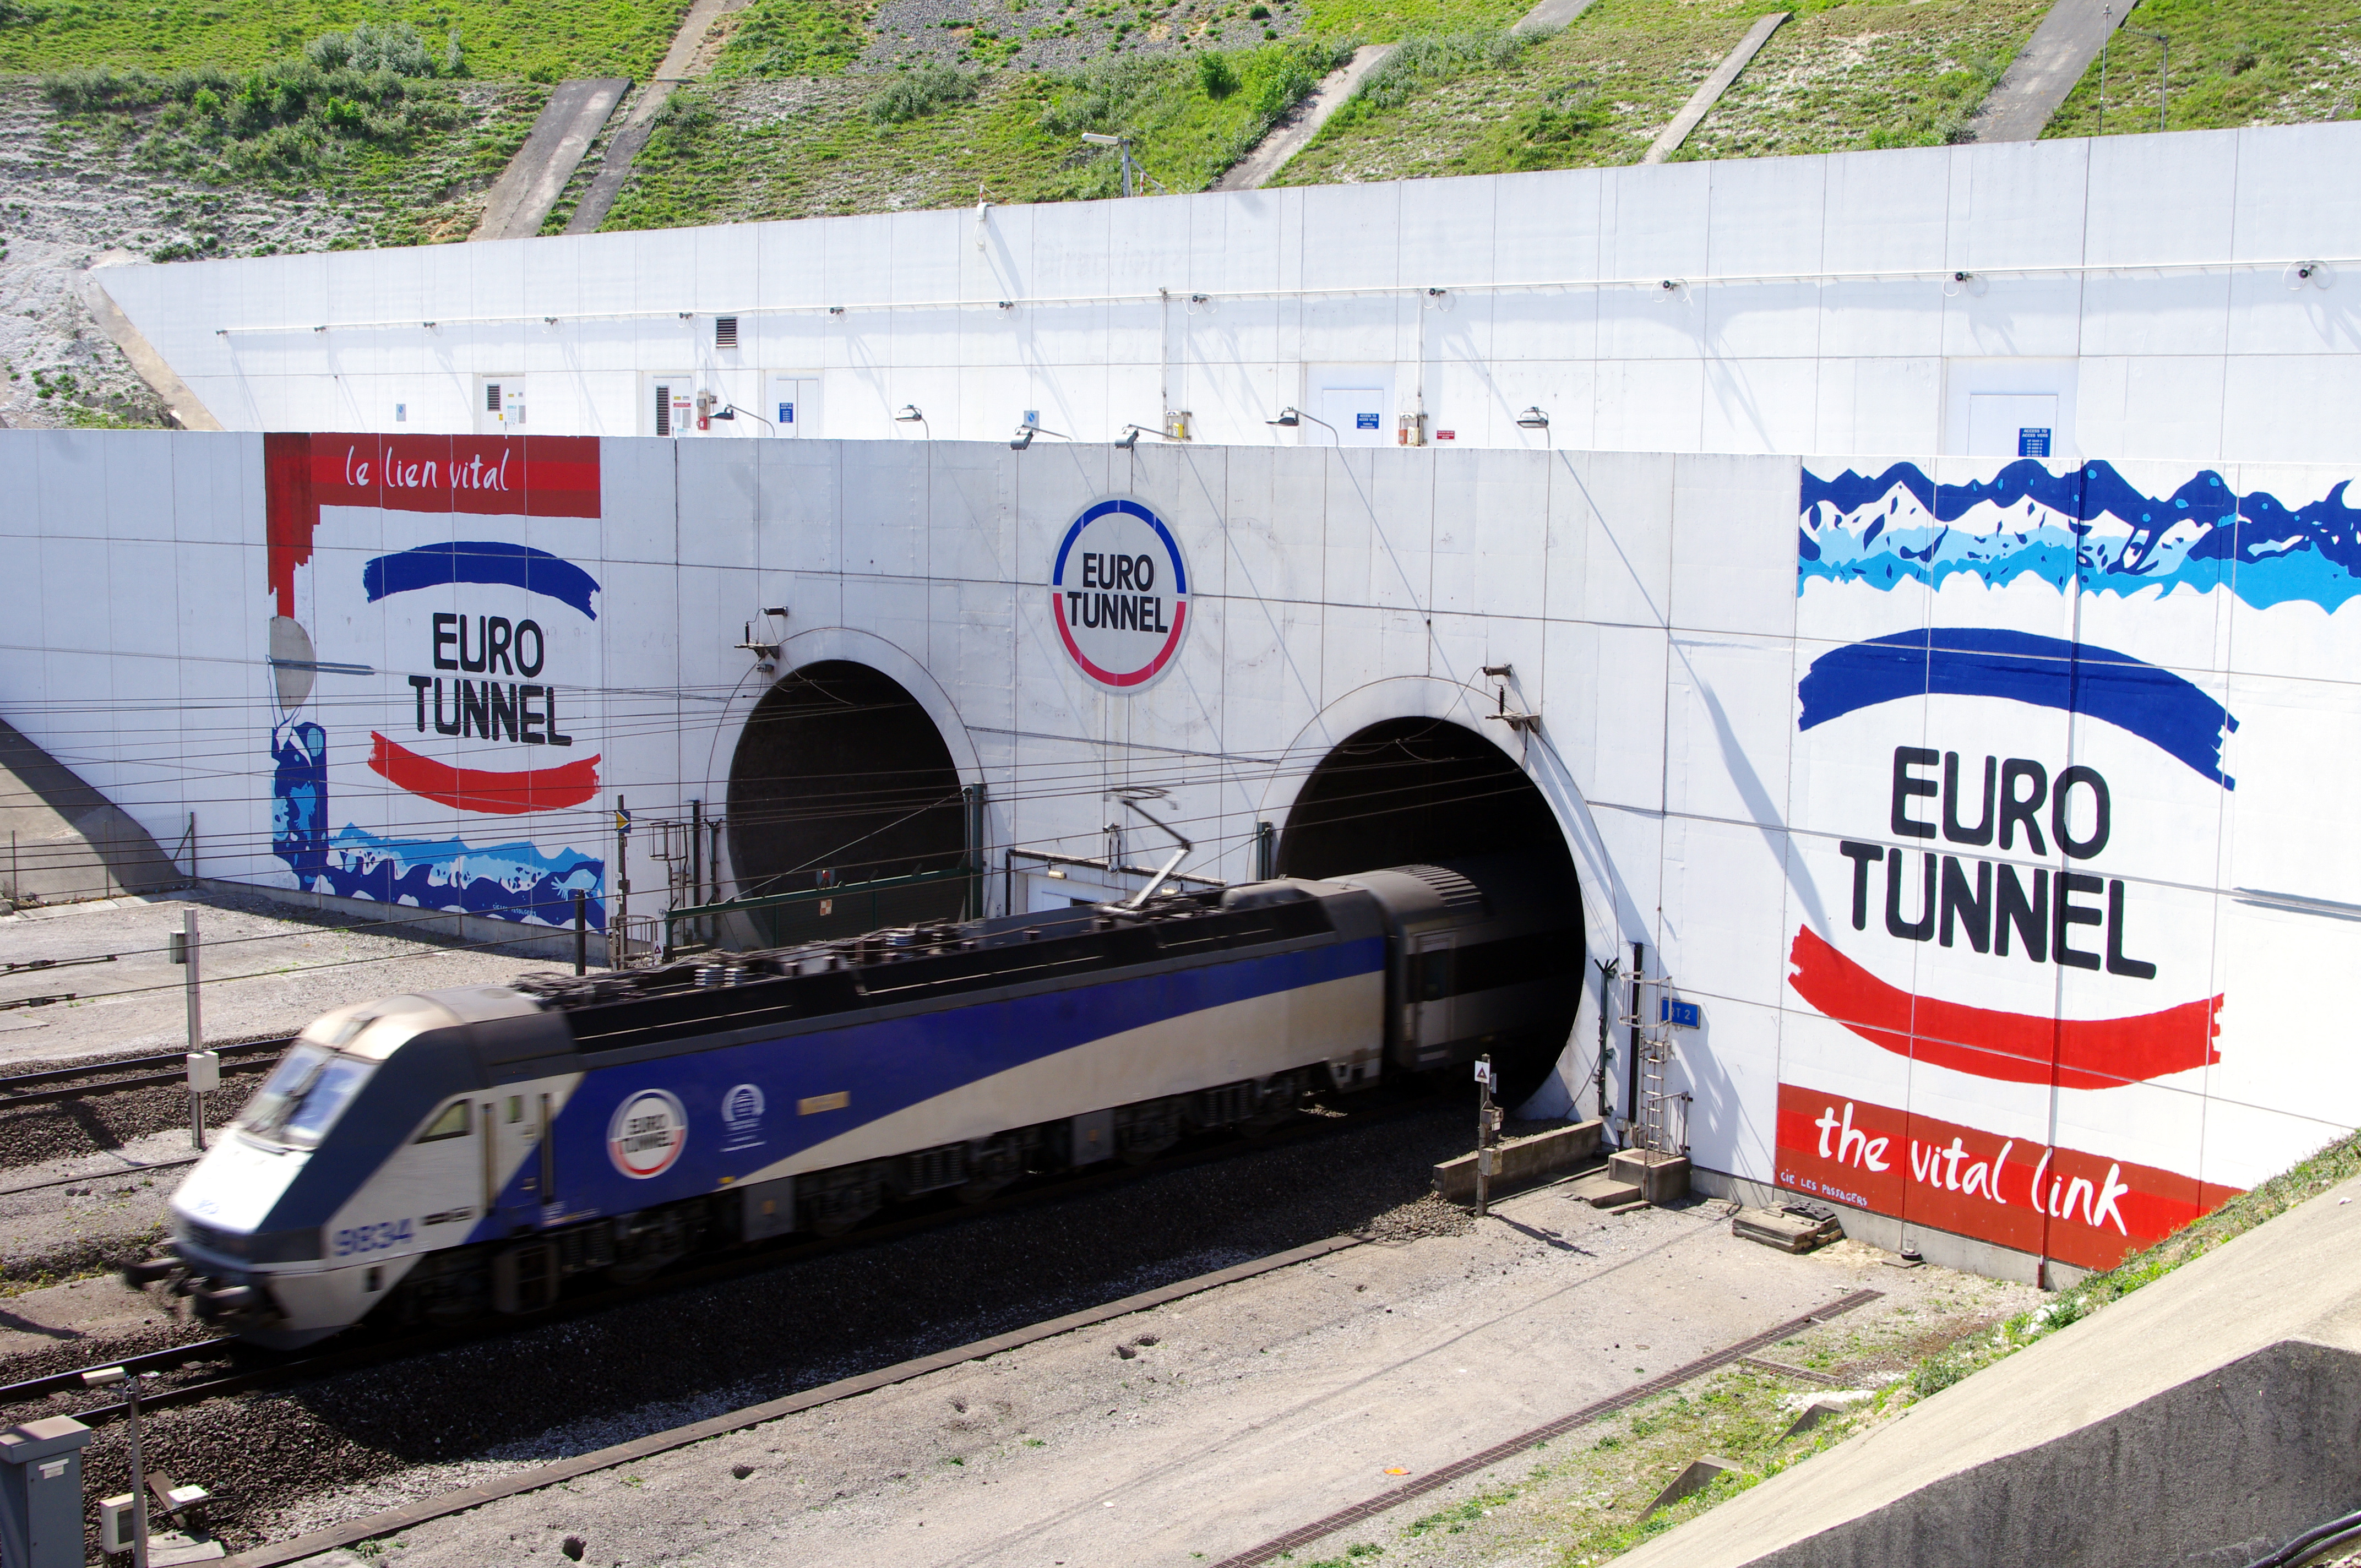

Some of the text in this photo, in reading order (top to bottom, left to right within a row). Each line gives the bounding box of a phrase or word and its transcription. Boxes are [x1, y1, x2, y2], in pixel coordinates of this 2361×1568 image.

[345, 445, 510, 491] le lien vital
[1083, 553, 1154, 591] EURO
[1068, 591, 1168, 633] TUNNEL
[432, 612, 544, 678] EURO
[408, 676, 572, 747] TUNNEL
[1891, 746, 2110, 859] EURO
[1840, 841, 2157, 979] TUNNEL
[1685, 1009, 1690, 1020] 2
[1801, 1178, 1817, 1191] LES
[1822, 1184, 1868, 1206] PASSAGERS
[1815, 1102, 2128, 1236] the vital link
[332, 1218, 414, 1256] 9834
